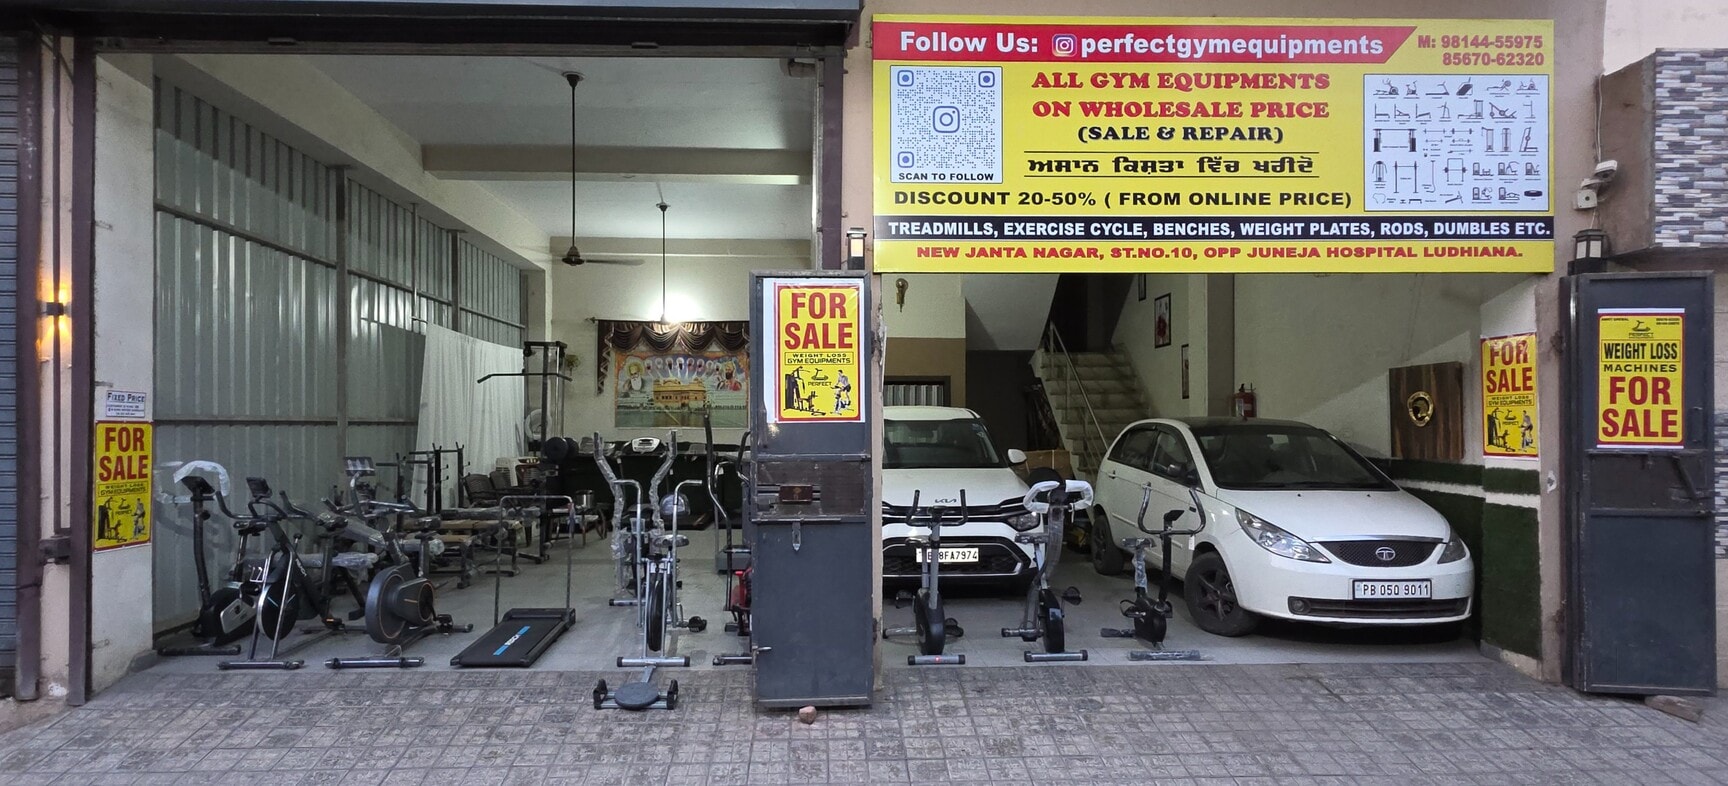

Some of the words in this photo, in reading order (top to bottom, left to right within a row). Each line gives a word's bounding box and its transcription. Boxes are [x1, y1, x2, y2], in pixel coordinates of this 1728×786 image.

[901, 31, 986, 52] Follow
[997, 33, 1038, 53] Us:
[1081, 33, 1383, 58] perfectgymequipments
[1418, 35, 1435, 48] M:
[1442, 35, 1543, 49] 98144-55975
[1443, 52, 1544, 66] 85670-62320
[1032, 72, 1083, 88] ALL
[1090, 72, 1150, 88] GYM
[1158, 72, 1330, 90] EQUIPMENTS
[1032, 101, 1071, 118] ON
[1079, 101, 1243, 118] WHOLESALE
[1250, 101, 1329, 118] PRICE
[1078, 127, 1149, 143] (SALE
[1157, 127, 1175, 140] &
[1183, 127, 1283, 144] REPAIR)
[1028, 160, 1099, 173] ਅਸਾਨ
[1197, 156, 1240, 173] ਵਿੱਚ
[950, 173, 994, 181] FOLLOW
[895, 191, 1010, 205] DISCOUNT
[1018, 191, 1096, 206] 20-50%
[1119, 192, 1180, 205] FROM
[1189, 192, 1271, 205] ONLINE
[1280, 192, 1351, 208] PRICE)
[889, 222, 999, 238] TREADMILLS,
[1004, 222, 1085, 236] EXERCISE
[1090, 222, 1148, 238] CYCLE,
[1154, 222, 1235, 238] BENCHES,
[1241, 223, 1304, 235] WEIGHT
[1310, 223, 1375, 238] PLATES,
[1380, 223, 1429, 238] RODS,
[1434, 223, 1510, 235] DUMBLES
[1515, 223, 1550, 235] ETC.
[917, 247, 960, 258] NEW
[966, 247, 1027, 258] JANTA
[1033, 247, 1104, 260] NAGAR,
[1110, 247, 1197, 260] ST.NO.10,
[1203, 247, 1242, 258] OPP
[1247, 247, 1321, 258] JUNEJA
[1326, 247, 1418, 258] HOSPITAL
[1423, 247, 1523, 258] LUDHIANA.
[791, 292, 847, 319] FOR
[785, 323, 853, 349] SALE
[1490, 340, 1528, 366] FOR
[1604, 343, 1647, 360] WEIGHT
[1650, 343, 1677, 360] LOSS
[1604, 364, 1677, 372] MACHINES
[1487, 367, 1533, 393] SALE
[1610, 376, 1671, 405] FOR
[1602, 408, 1678, 437] SALE
[104, 427, 145, 452] FOR
[99, 455, 149, 482] SALE
[1363, 585, 1376, 595] PB
[1404, 584, 1428, 595] 9011
